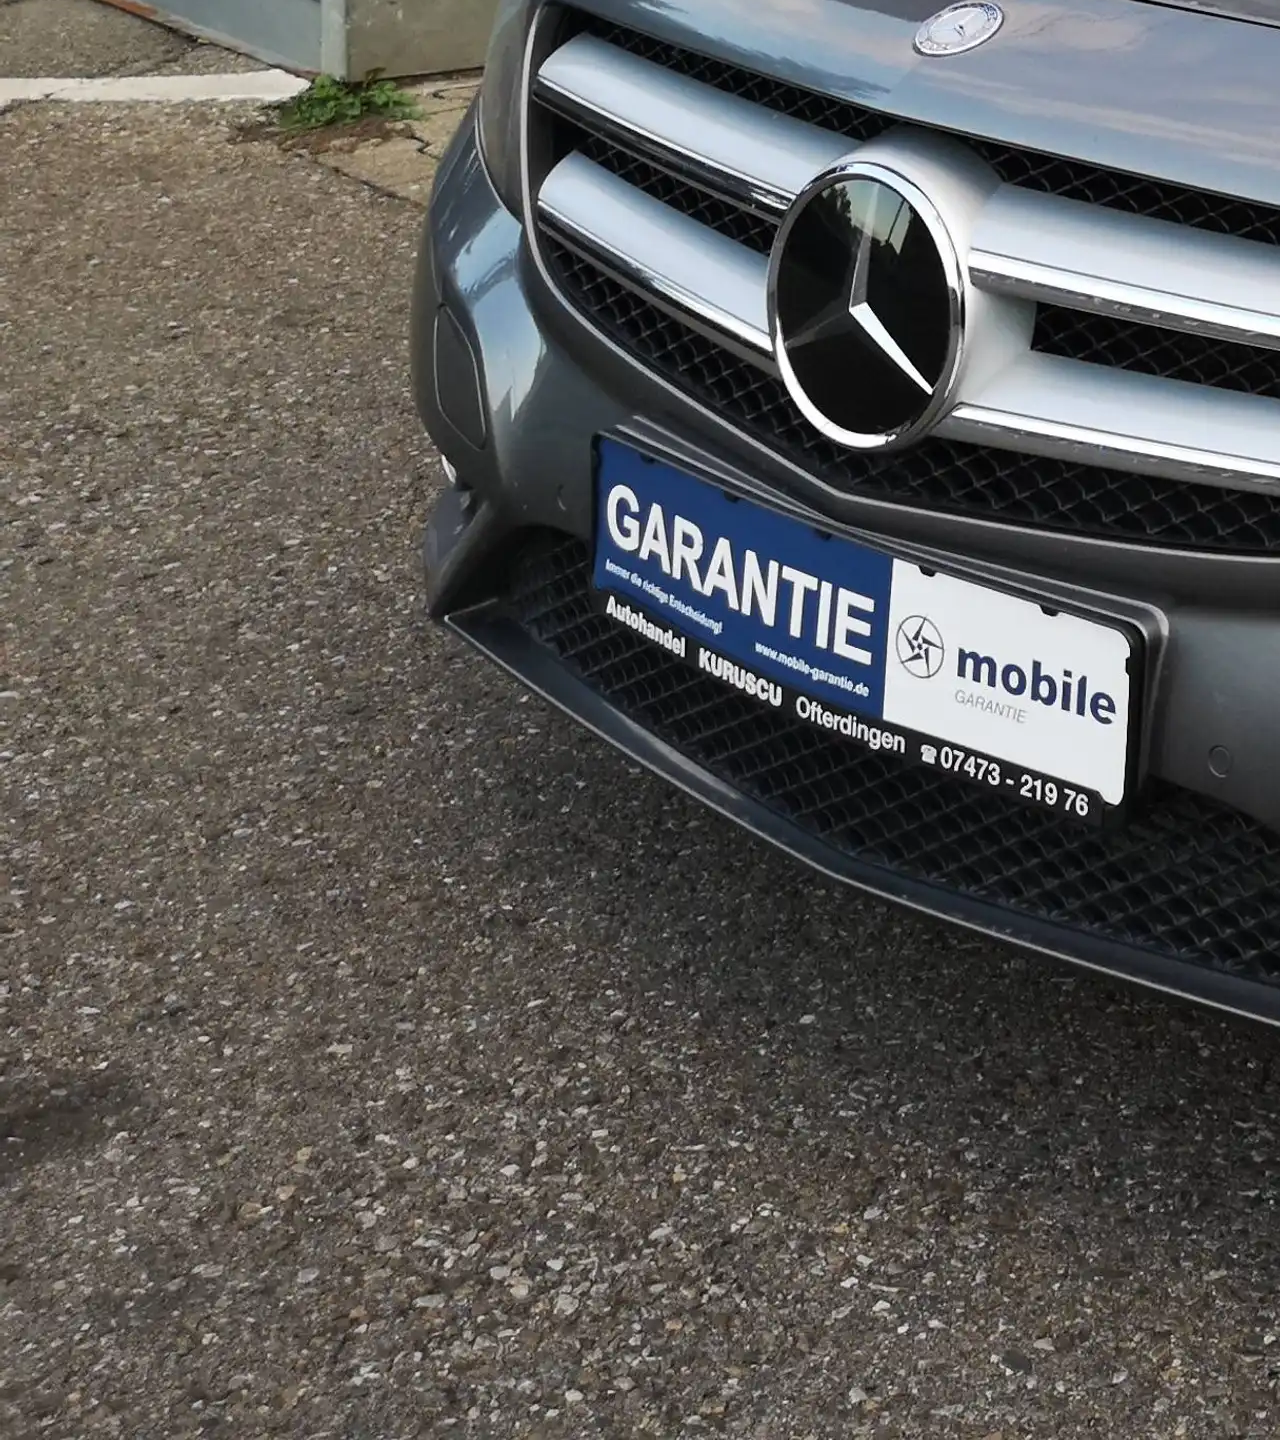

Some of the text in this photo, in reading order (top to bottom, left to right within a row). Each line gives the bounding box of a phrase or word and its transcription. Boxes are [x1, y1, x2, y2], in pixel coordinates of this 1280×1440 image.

[607, 484, 874, 665] GARANTIE
[606, 595, 686, 658] Autohandel
[698, 647, 783, 707] KURUSCU
[795, 695, 906, 754] Ofterdingen
[940, 746, 1000, 786] 07473
[1019, 774, 1058, 805] 219
[1063, 788, 1089, 816] 76
[754, 641, 870, 698] www.mobile-garantie.de
[954, 689, 1028, 725] GARANTIE
[957, 647, 1116, 725] mobile
